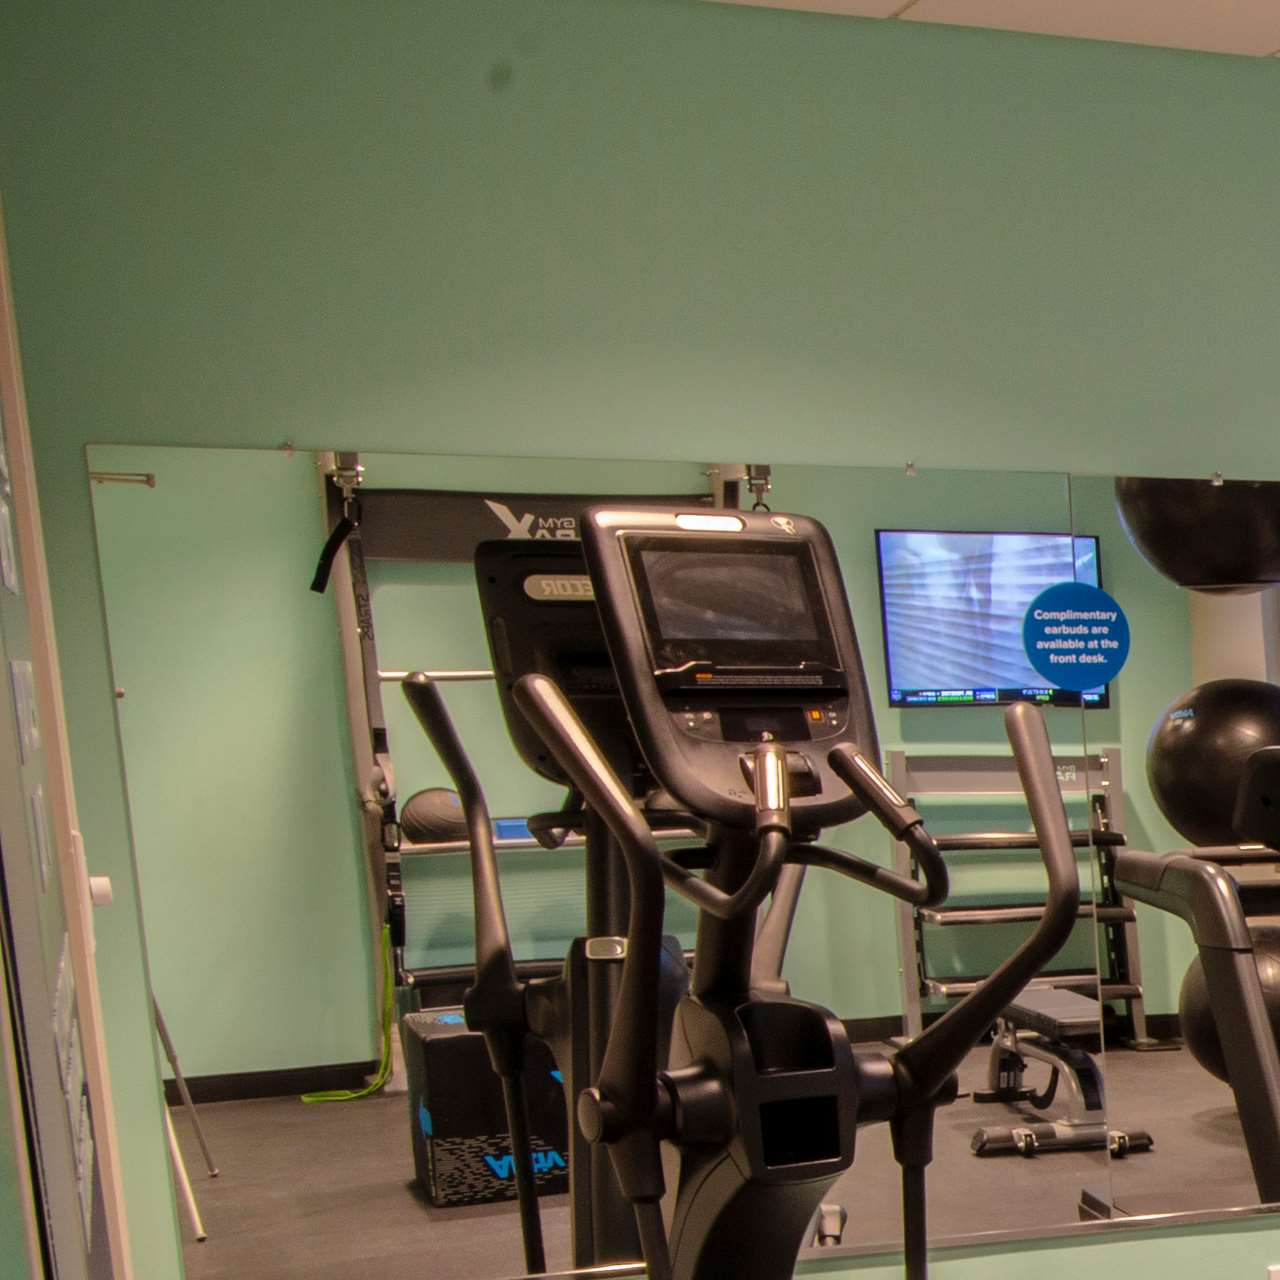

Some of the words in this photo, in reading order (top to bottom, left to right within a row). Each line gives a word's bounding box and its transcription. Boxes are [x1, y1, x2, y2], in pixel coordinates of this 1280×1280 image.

[1033, 609, 1117, 622] Complimentary
[1044, 625, 1089, 634] earbuds
[1091, 626, 1109, 634] are
[1036, 639, 1085, 649] available
[1087, 640, 1098, 649] at
[1101, 639, 1119, 649] the
[1049, 653, 1077, 663] front
[1079, 653, 1108, 663] desk.
